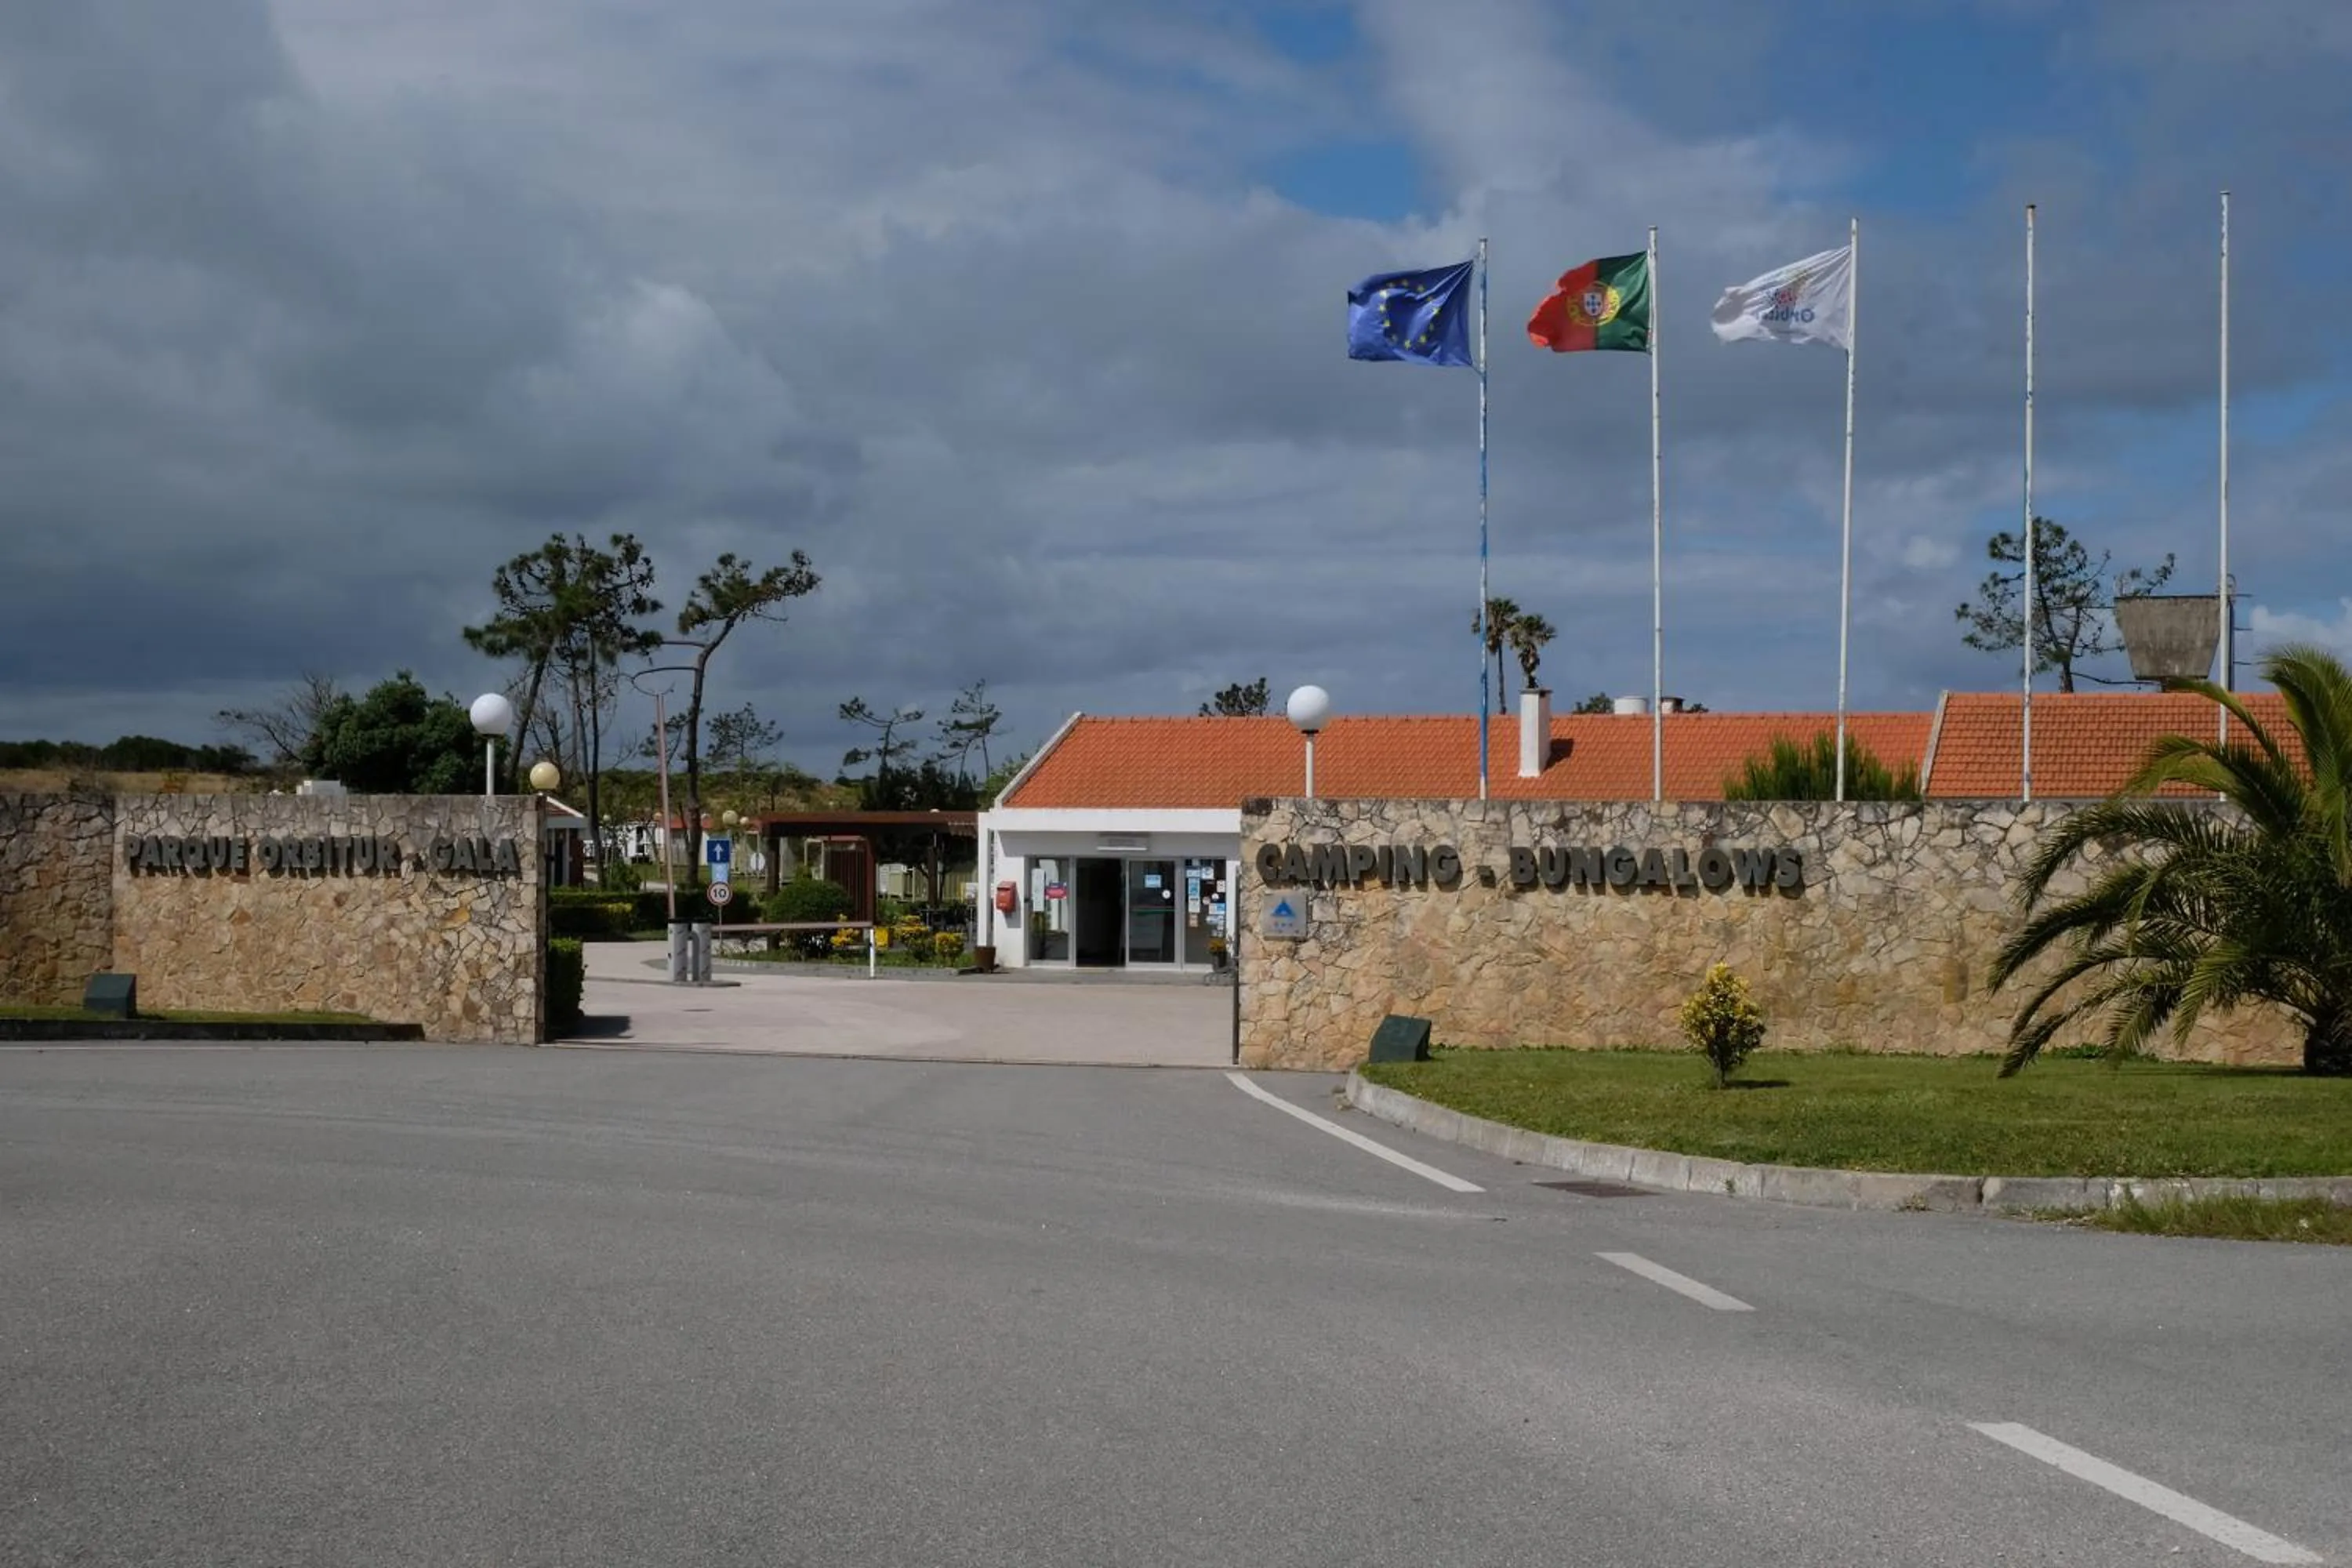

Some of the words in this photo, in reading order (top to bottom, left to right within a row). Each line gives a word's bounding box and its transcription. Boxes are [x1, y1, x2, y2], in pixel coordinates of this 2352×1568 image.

[123, 836, 246, 869] PARQUE
[257, 836, 401, 870] ORBITUR
[431, 837, 519, 871] GALA
[1256, 843, 1461, 884] CAMPING
[1510, 846, 1801, 887] BUNGALOWS
[713, 888, 727, 898] 10
